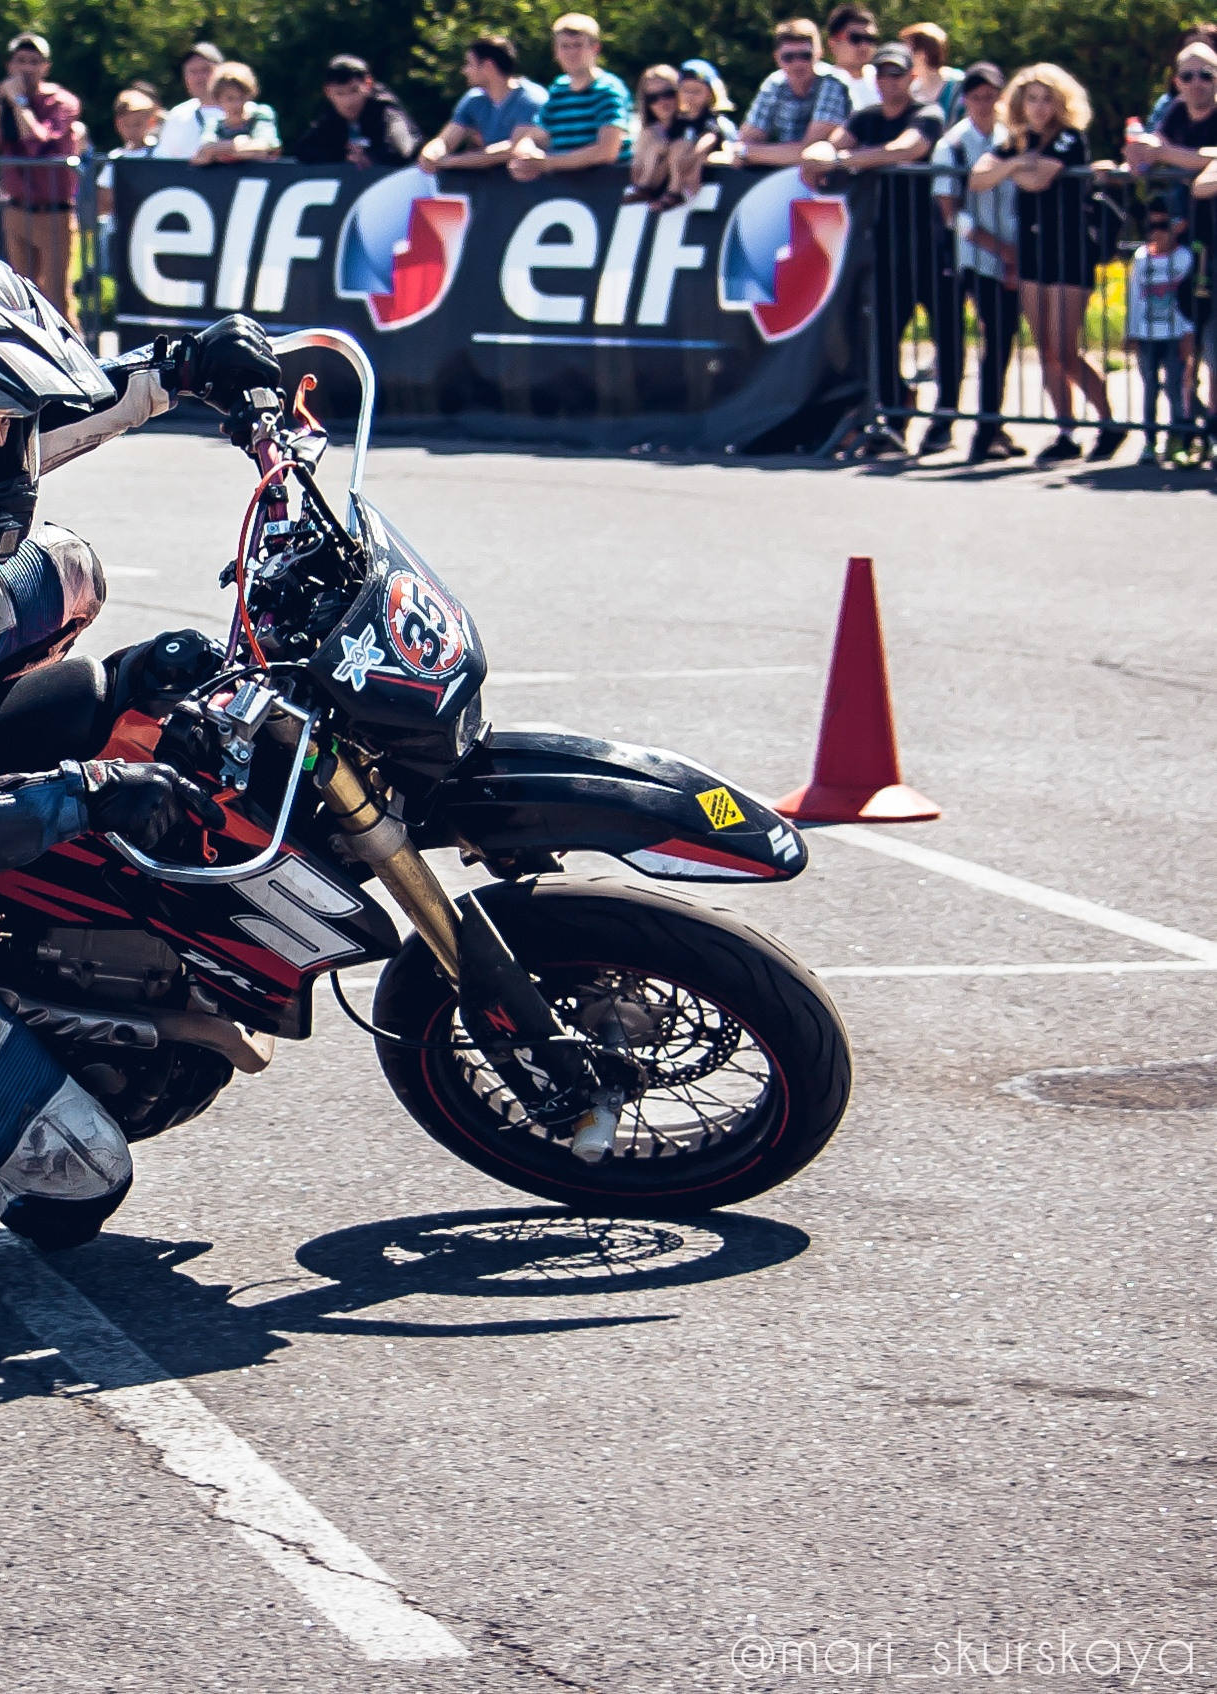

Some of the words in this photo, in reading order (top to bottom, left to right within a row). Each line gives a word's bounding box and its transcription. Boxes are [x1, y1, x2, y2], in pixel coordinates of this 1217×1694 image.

[128, 177, 342, 312] elf
[499, 183, 722, 327] elf
[401, 582, 447, 670] 35
